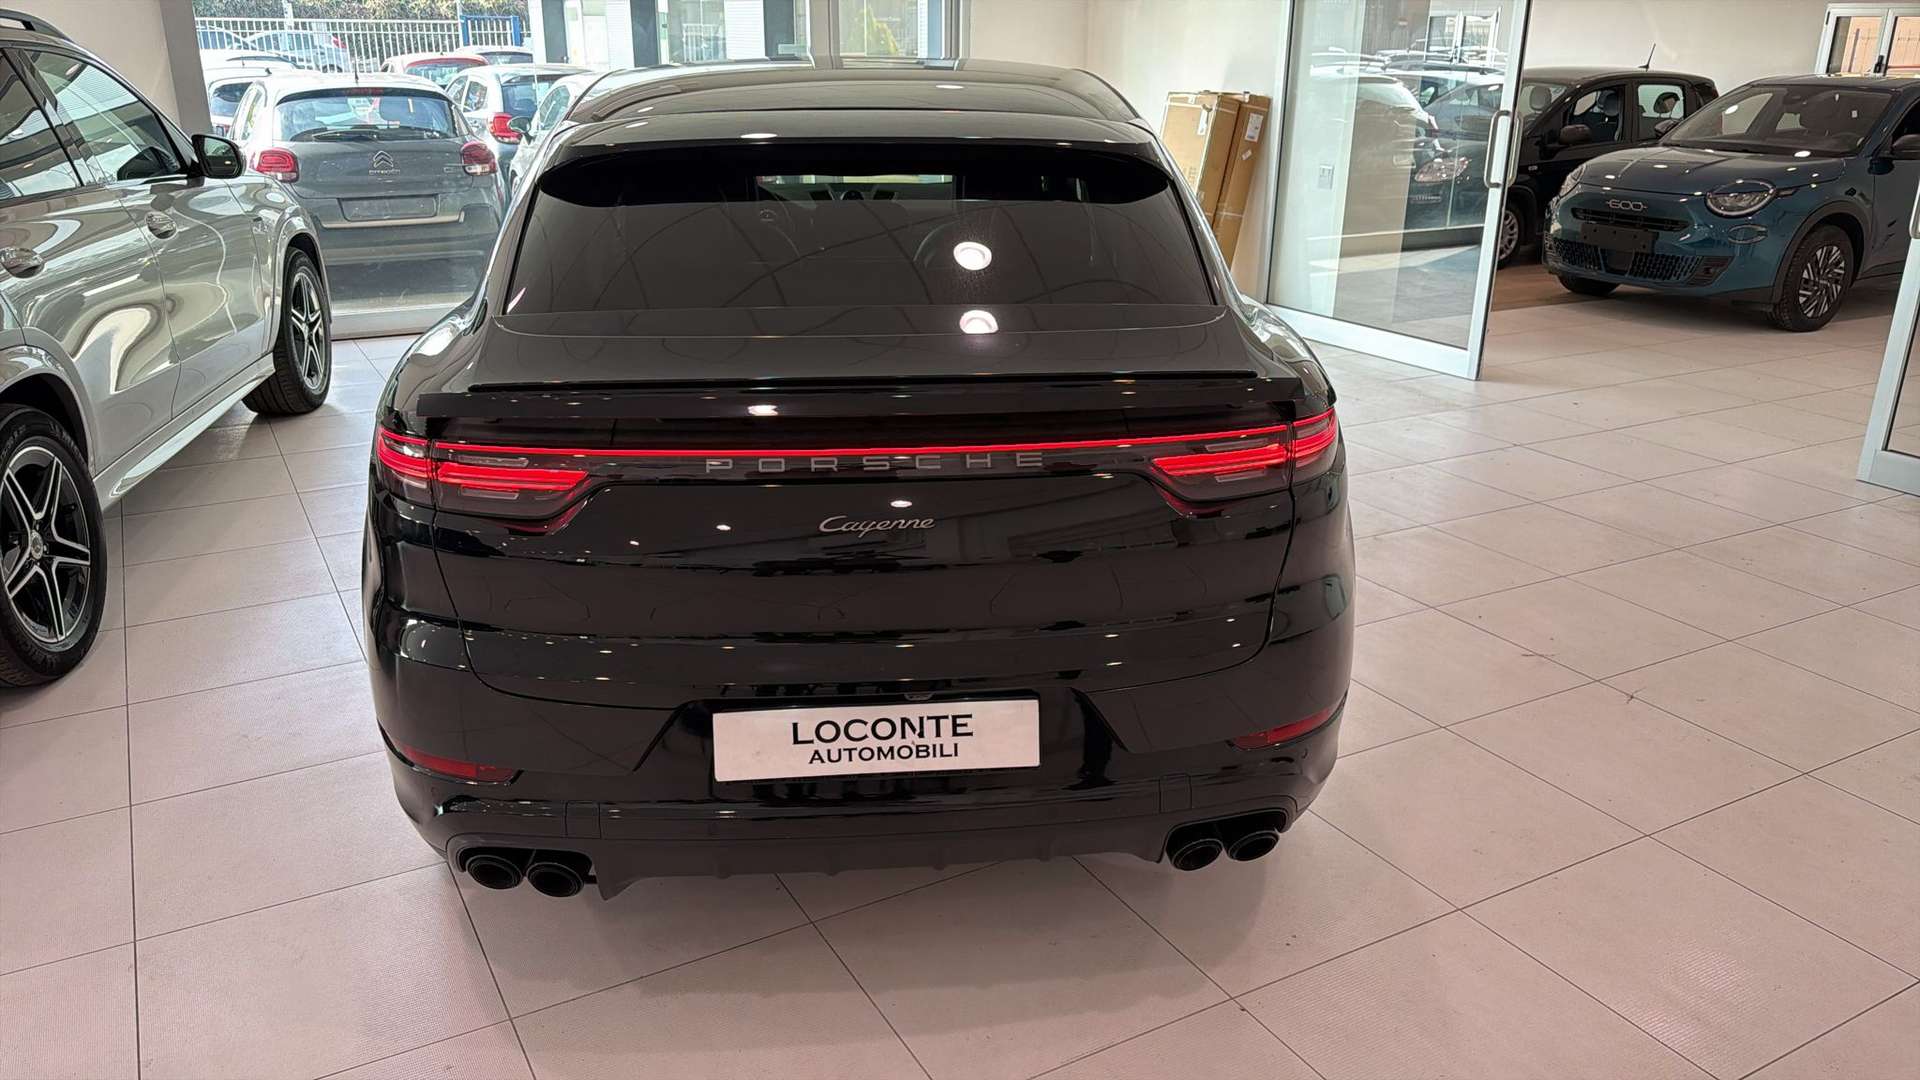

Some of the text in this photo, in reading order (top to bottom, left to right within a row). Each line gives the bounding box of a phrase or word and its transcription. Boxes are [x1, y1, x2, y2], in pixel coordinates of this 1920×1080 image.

[705, 452, 1043, 473] PORSCHE
[819, 515, 936, 538] Cayenne
[792, 713, 974, 745] LOCONTE
[808, 743, 959, 764] AUTOMOBILI
